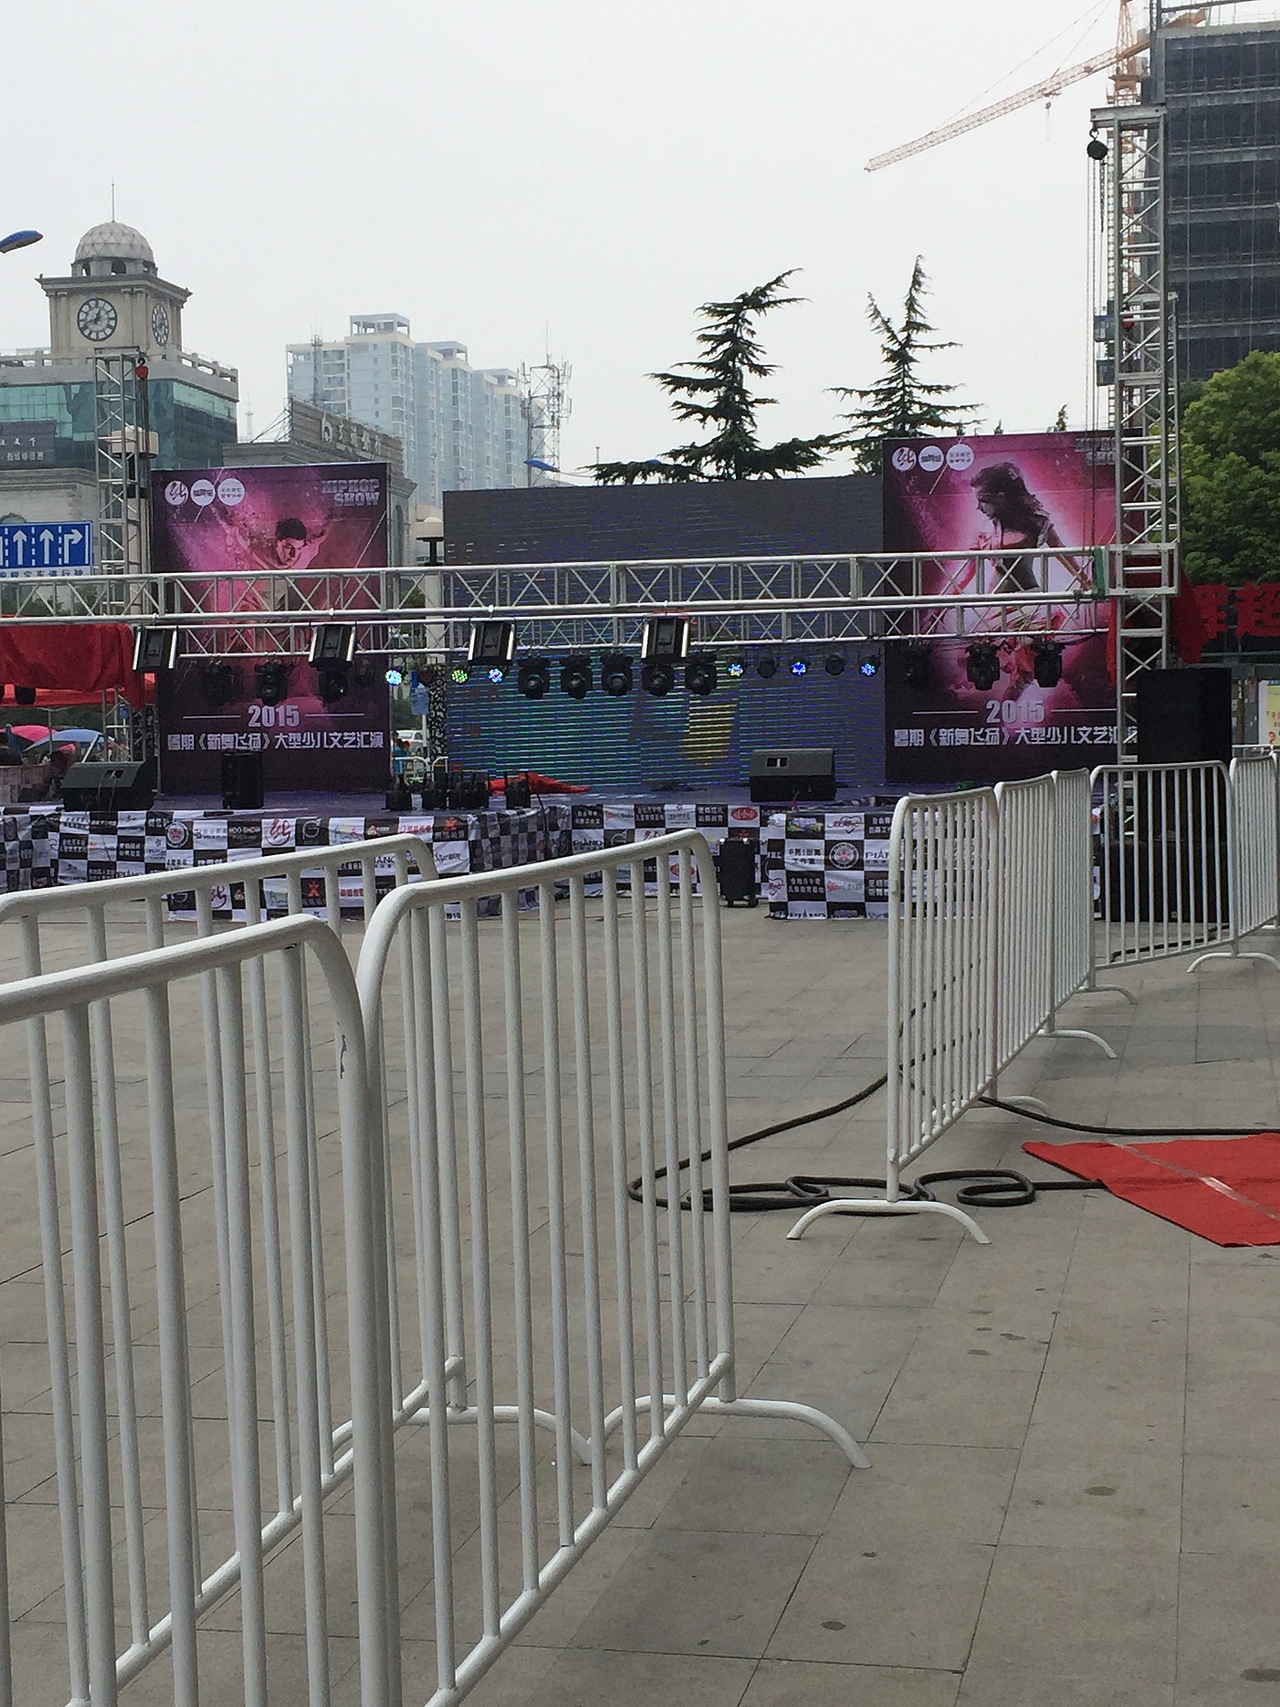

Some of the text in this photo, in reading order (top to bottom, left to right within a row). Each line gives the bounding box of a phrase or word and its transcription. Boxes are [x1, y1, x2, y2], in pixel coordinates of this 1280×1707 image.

[321, 478, 380, 494] HIPHOP
[333, 491, 380, 507] SHOW
[247, 704, 301, 728] 2015
[985, 699, 1046, 725] 2015
[167, 731, 385, 752] 暑期《新舞飞扬》大型少儿文艺汇演
